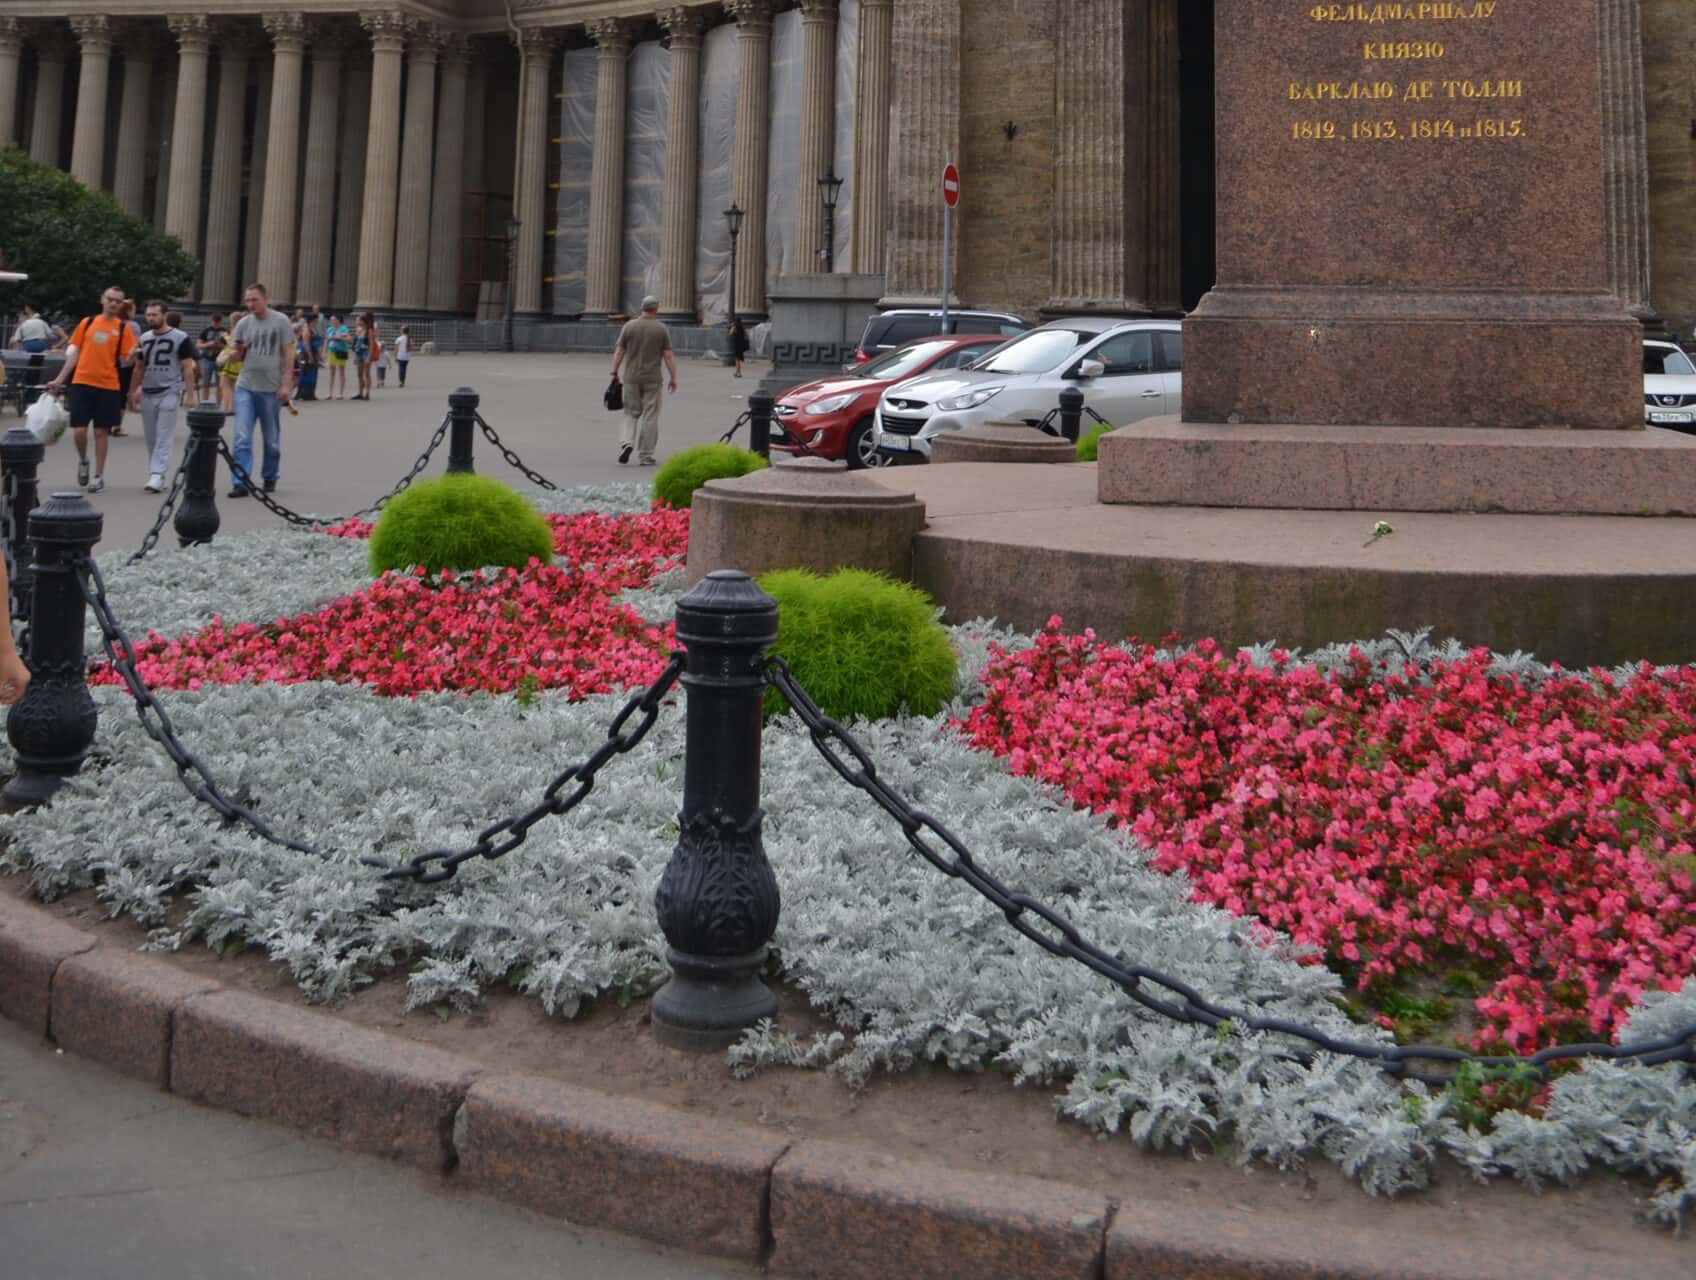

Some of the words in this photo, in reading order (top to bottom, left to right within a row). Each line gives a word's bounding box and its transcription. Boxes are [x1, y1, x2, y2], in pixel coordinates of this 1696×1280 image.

[1310, 1, 1497, 24] ФЕЛЬДМАРШАЛУ
[1363, 42, 1444, 60] КНЯЗЮ
[1288, 80, 1393, 100] БАРКЛАЮ
[1403, 80, 1433, 103] ДЕ
[1442, 79, 1522, 98] ТОЛЛИ
[1410, 119, 1454, 139] 1814
[143, 339, 174, 366] 72
